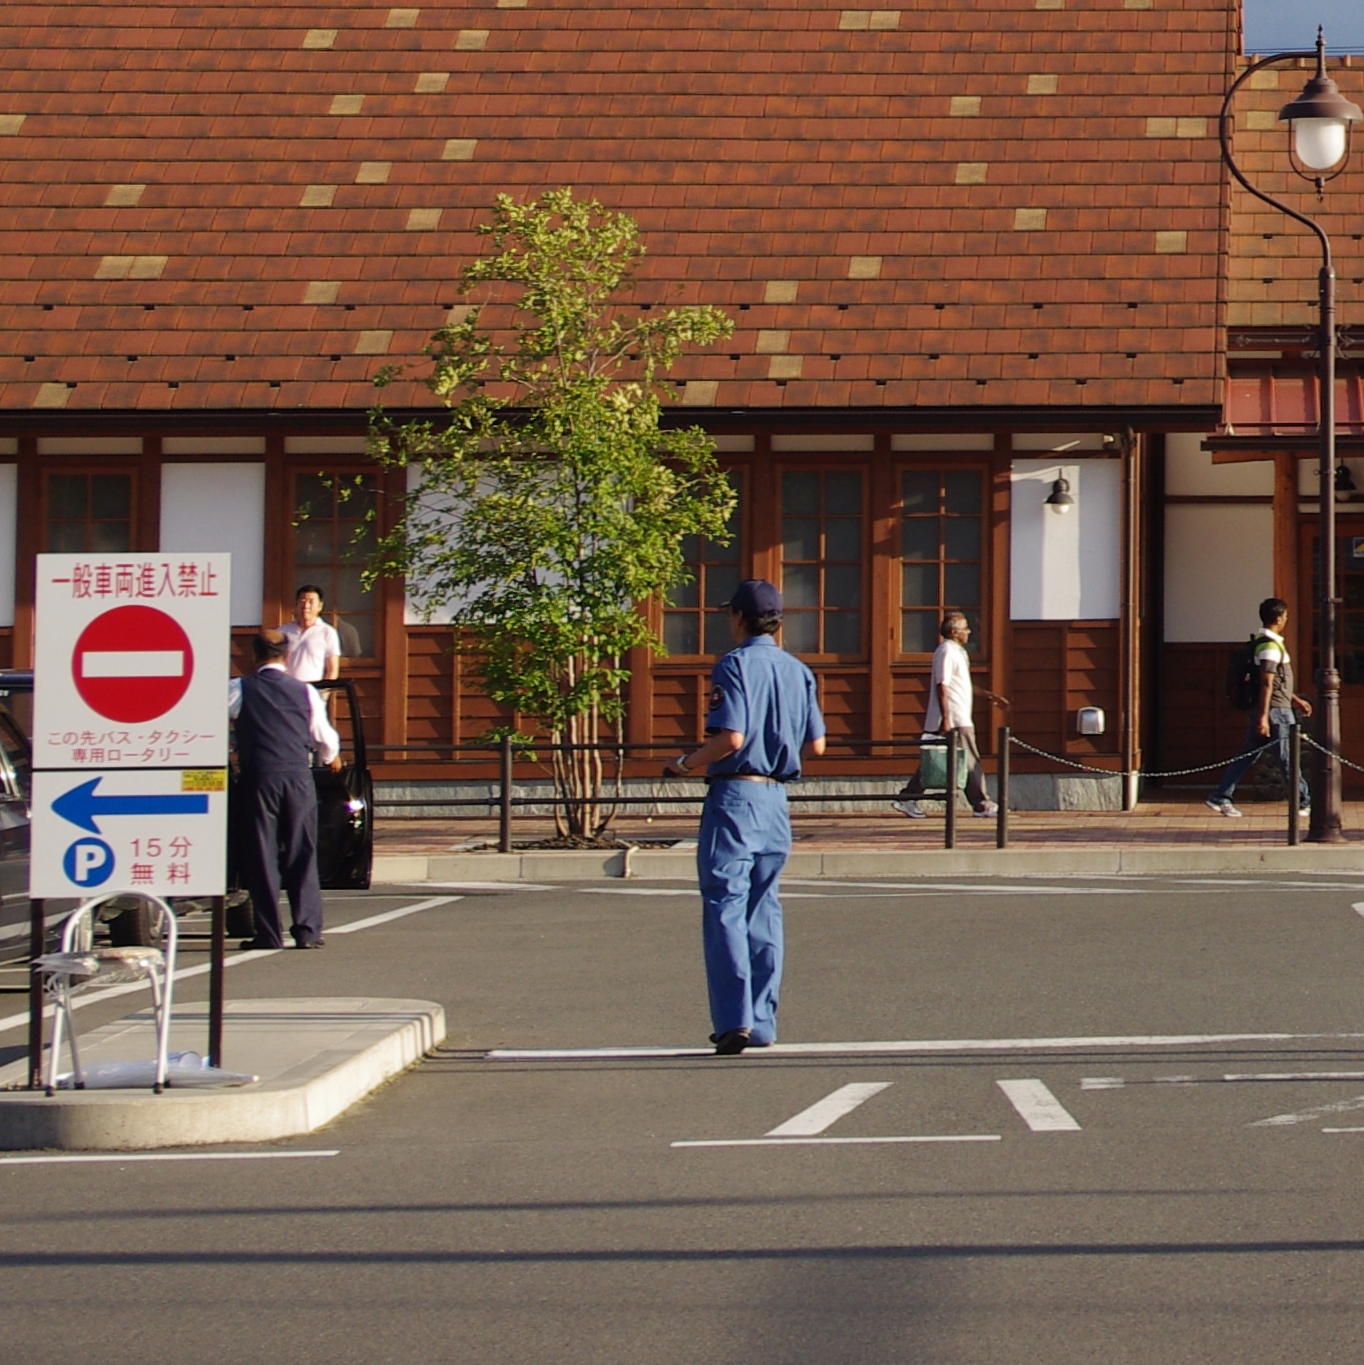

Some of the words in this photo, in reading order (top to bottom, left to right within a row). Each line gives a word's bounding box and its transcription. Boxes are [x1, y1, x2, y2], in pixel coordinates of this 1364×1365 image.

[51, 561, 219, 599] 一般車両進入禁止
[48, 729, 216, 747] この先バス・タクシー
[71, 747, 190, 764] 専用ロータリー
[129, 836, 193, 859] 15分
[75, 844, 107, 882] P
[129, 861, 191, 886] 無料
